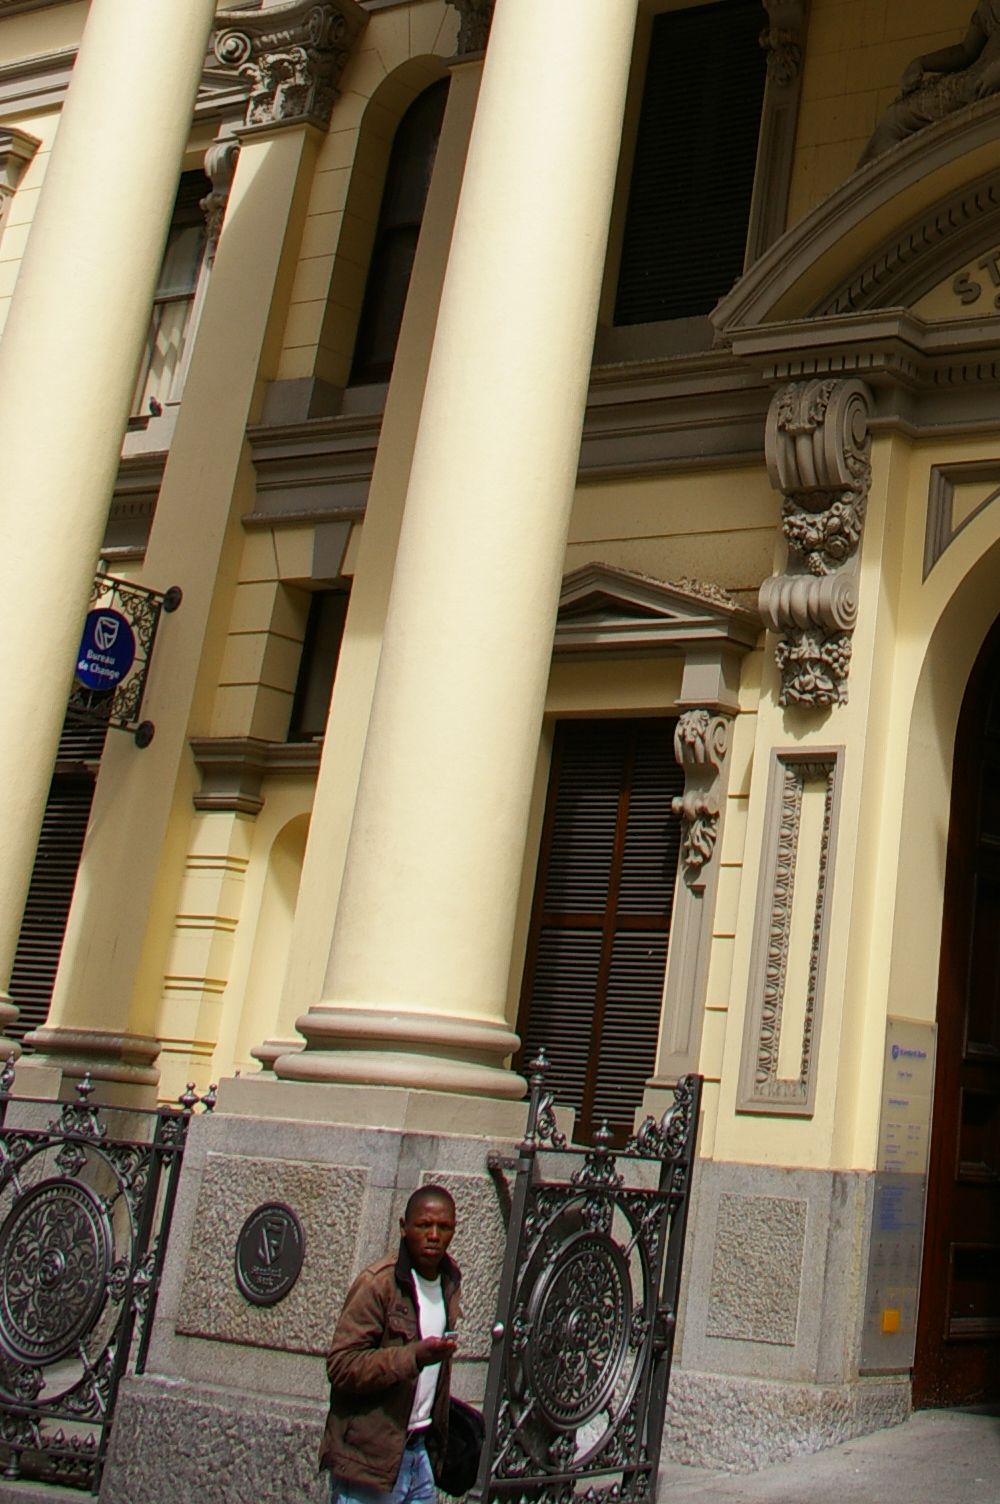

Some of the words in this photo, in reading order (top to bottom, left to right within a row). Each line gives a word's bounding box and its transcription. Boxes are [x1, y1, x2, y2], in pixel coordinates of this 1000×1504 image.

[88, 649, 115, 665] Bureau
[79, 660, 89, 671] de
[91, 663, 120, 679] Change
